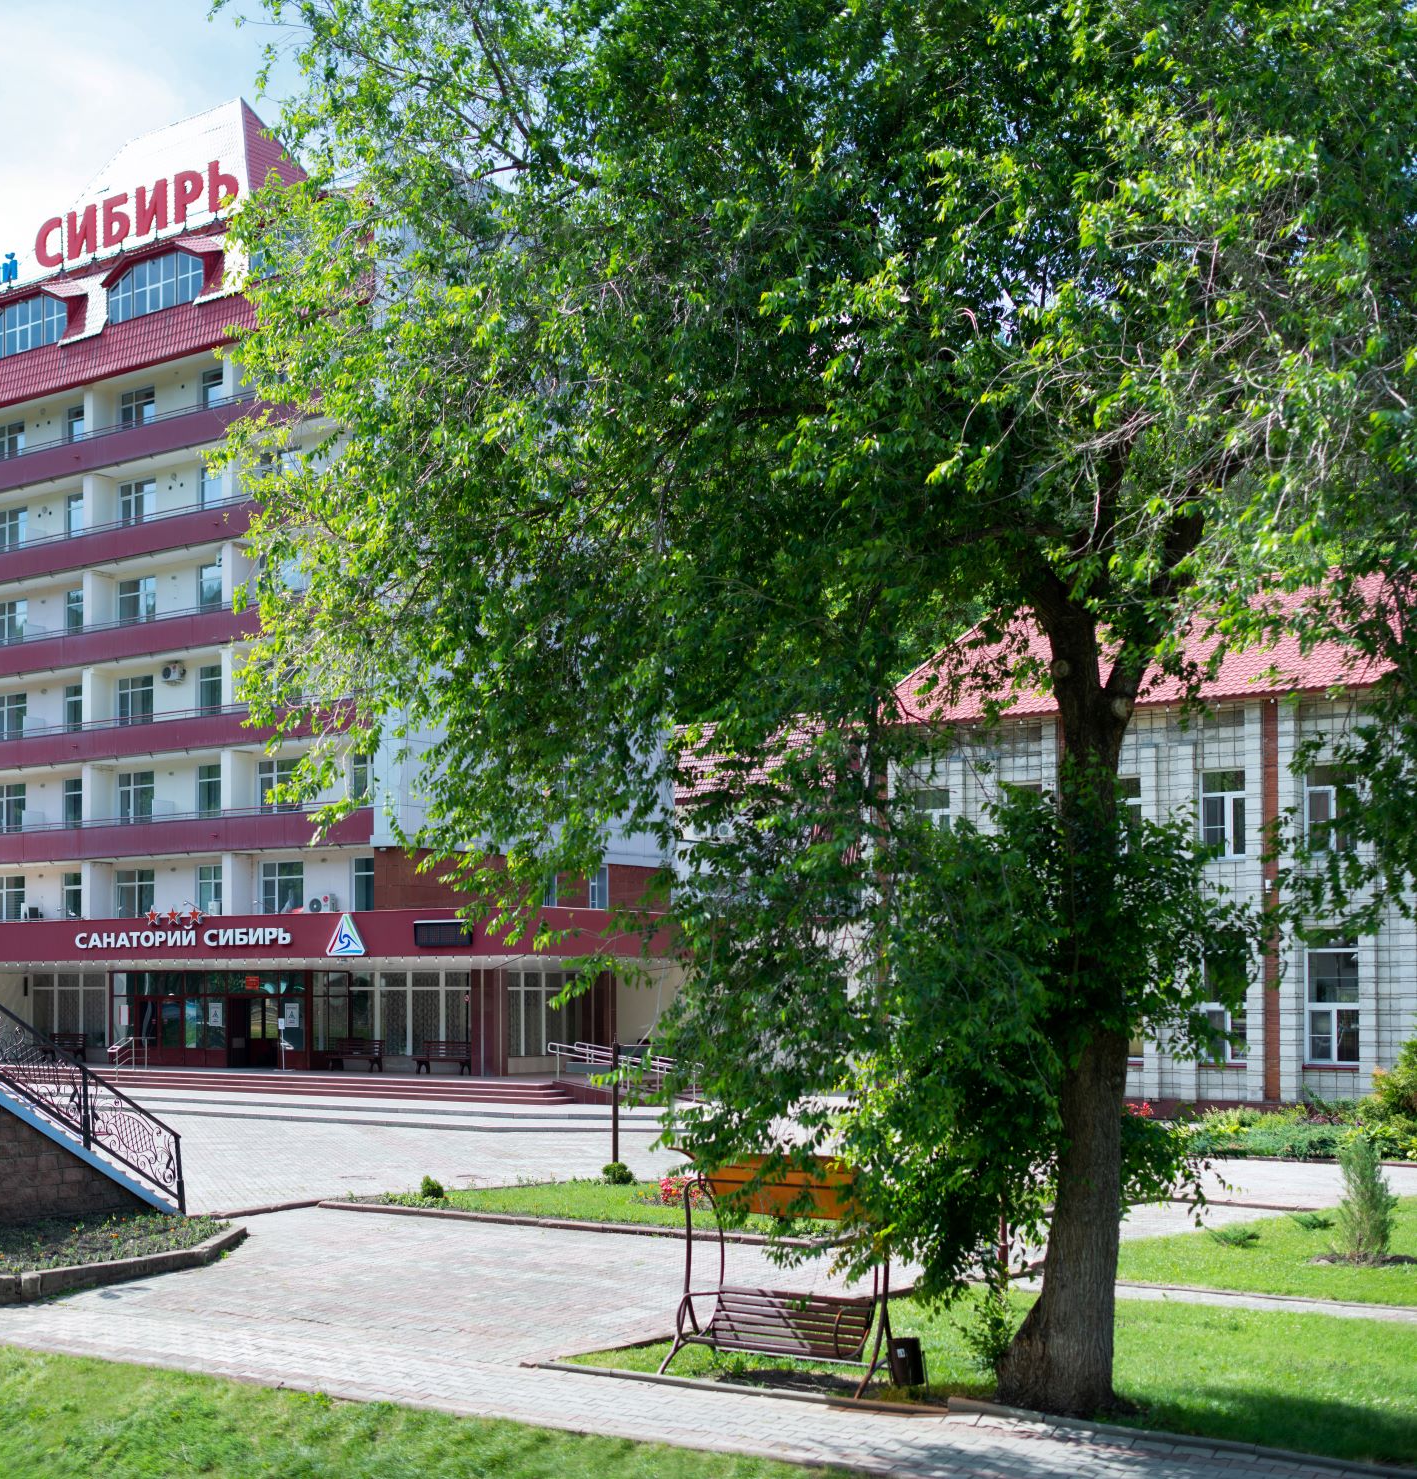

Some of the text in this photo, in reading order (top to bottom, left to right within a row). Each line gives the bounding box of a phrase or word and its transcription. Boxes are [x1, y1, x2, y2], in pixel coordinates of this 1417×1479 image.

[35, 160, 239, 268] СИБИРЬ
[75, 925, 291, 949] САНАТОРИЙ СИБИРЬ
